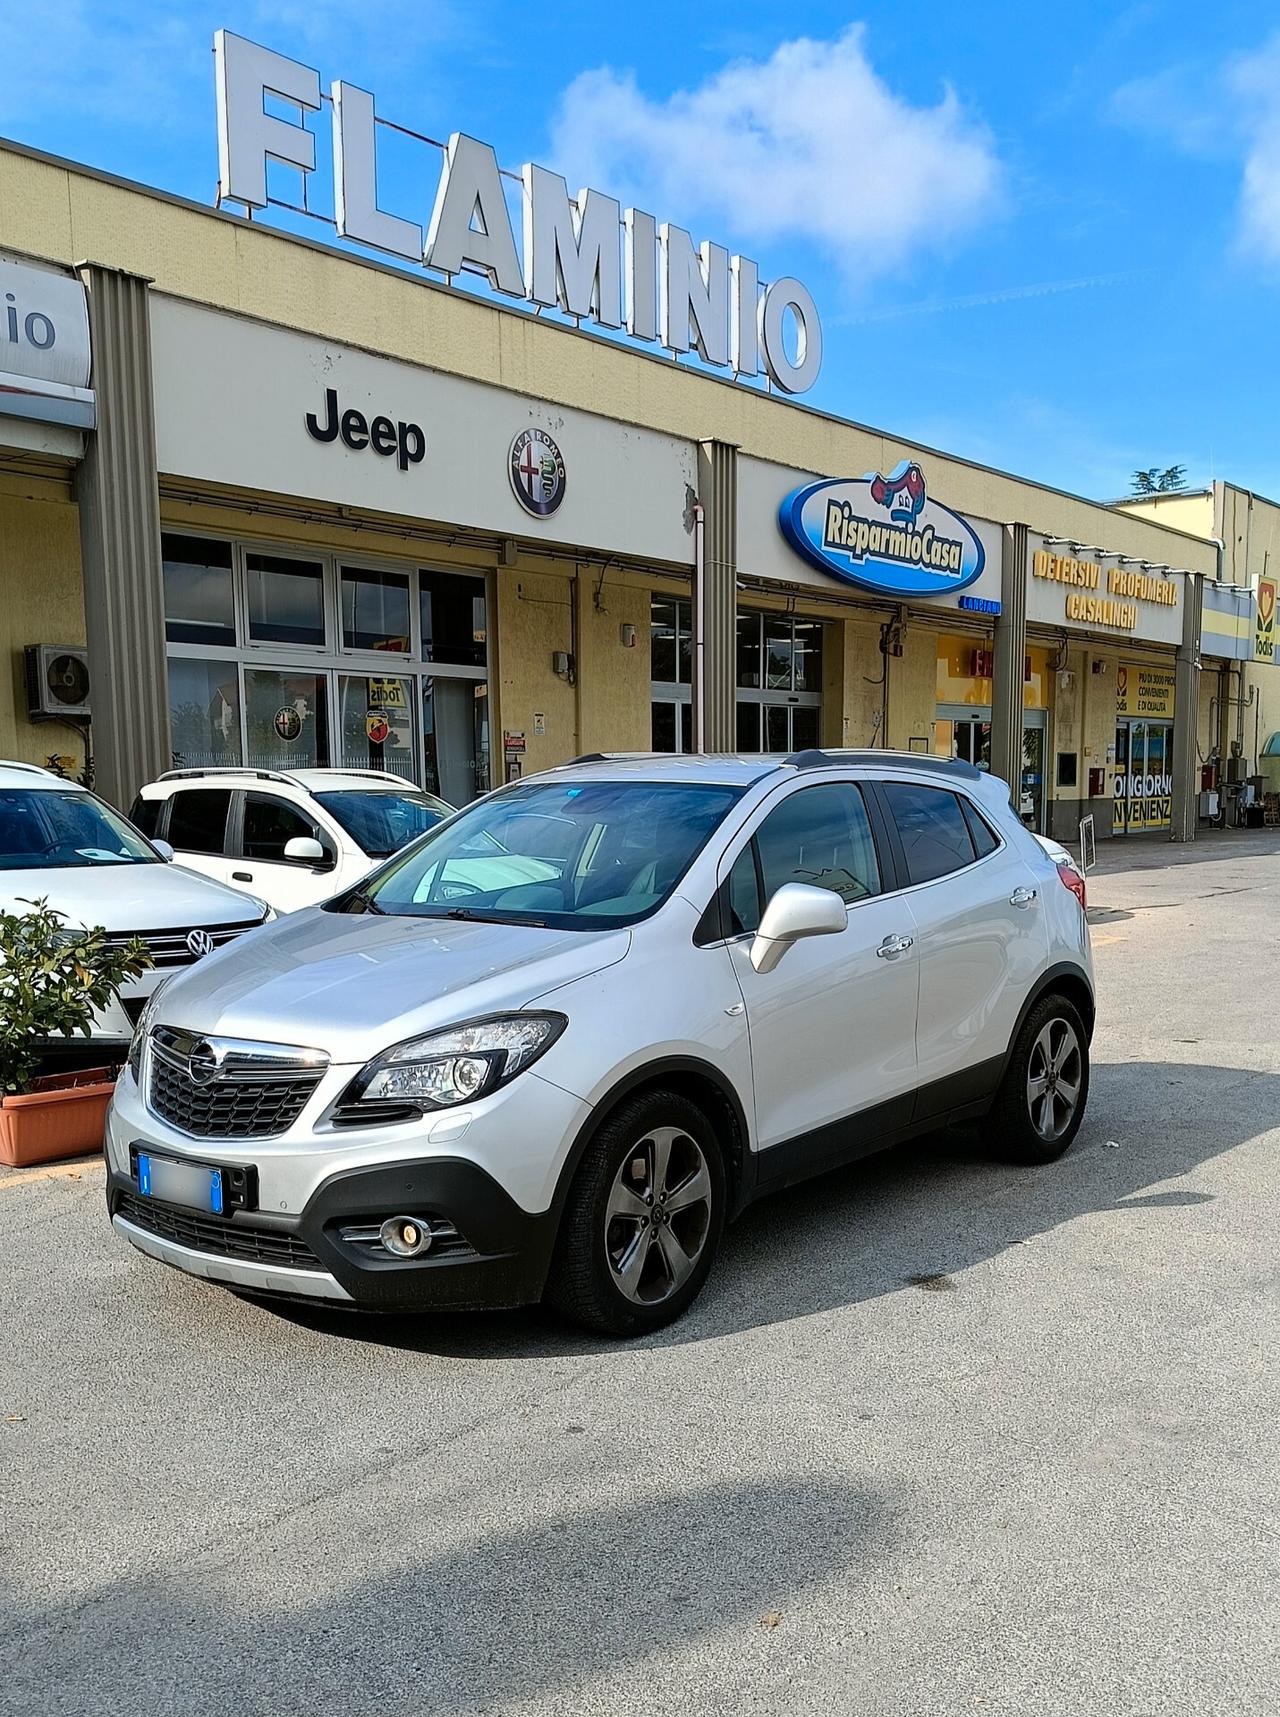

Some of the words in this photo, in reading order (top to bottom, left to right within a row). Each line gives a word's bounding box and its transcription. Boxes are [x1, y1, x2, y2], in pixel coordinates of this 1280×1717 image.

[213, 28, 823, 394] FLAMINIO
[305, 387, 426, 472] Jeep
[512, 432, 531, 470] ALFA
[535, 431, 565, 478] ROMEO
[825, 500, 963, 574] RisparmioCasa
[1033, 550, 1101, 589] DETERSIVI
[1107, 568, 1178, 606] PROFUMERIA
[1066, 594, 1137, 629] CASALINGHI
[1255, 634, 1273, 657] Todis
